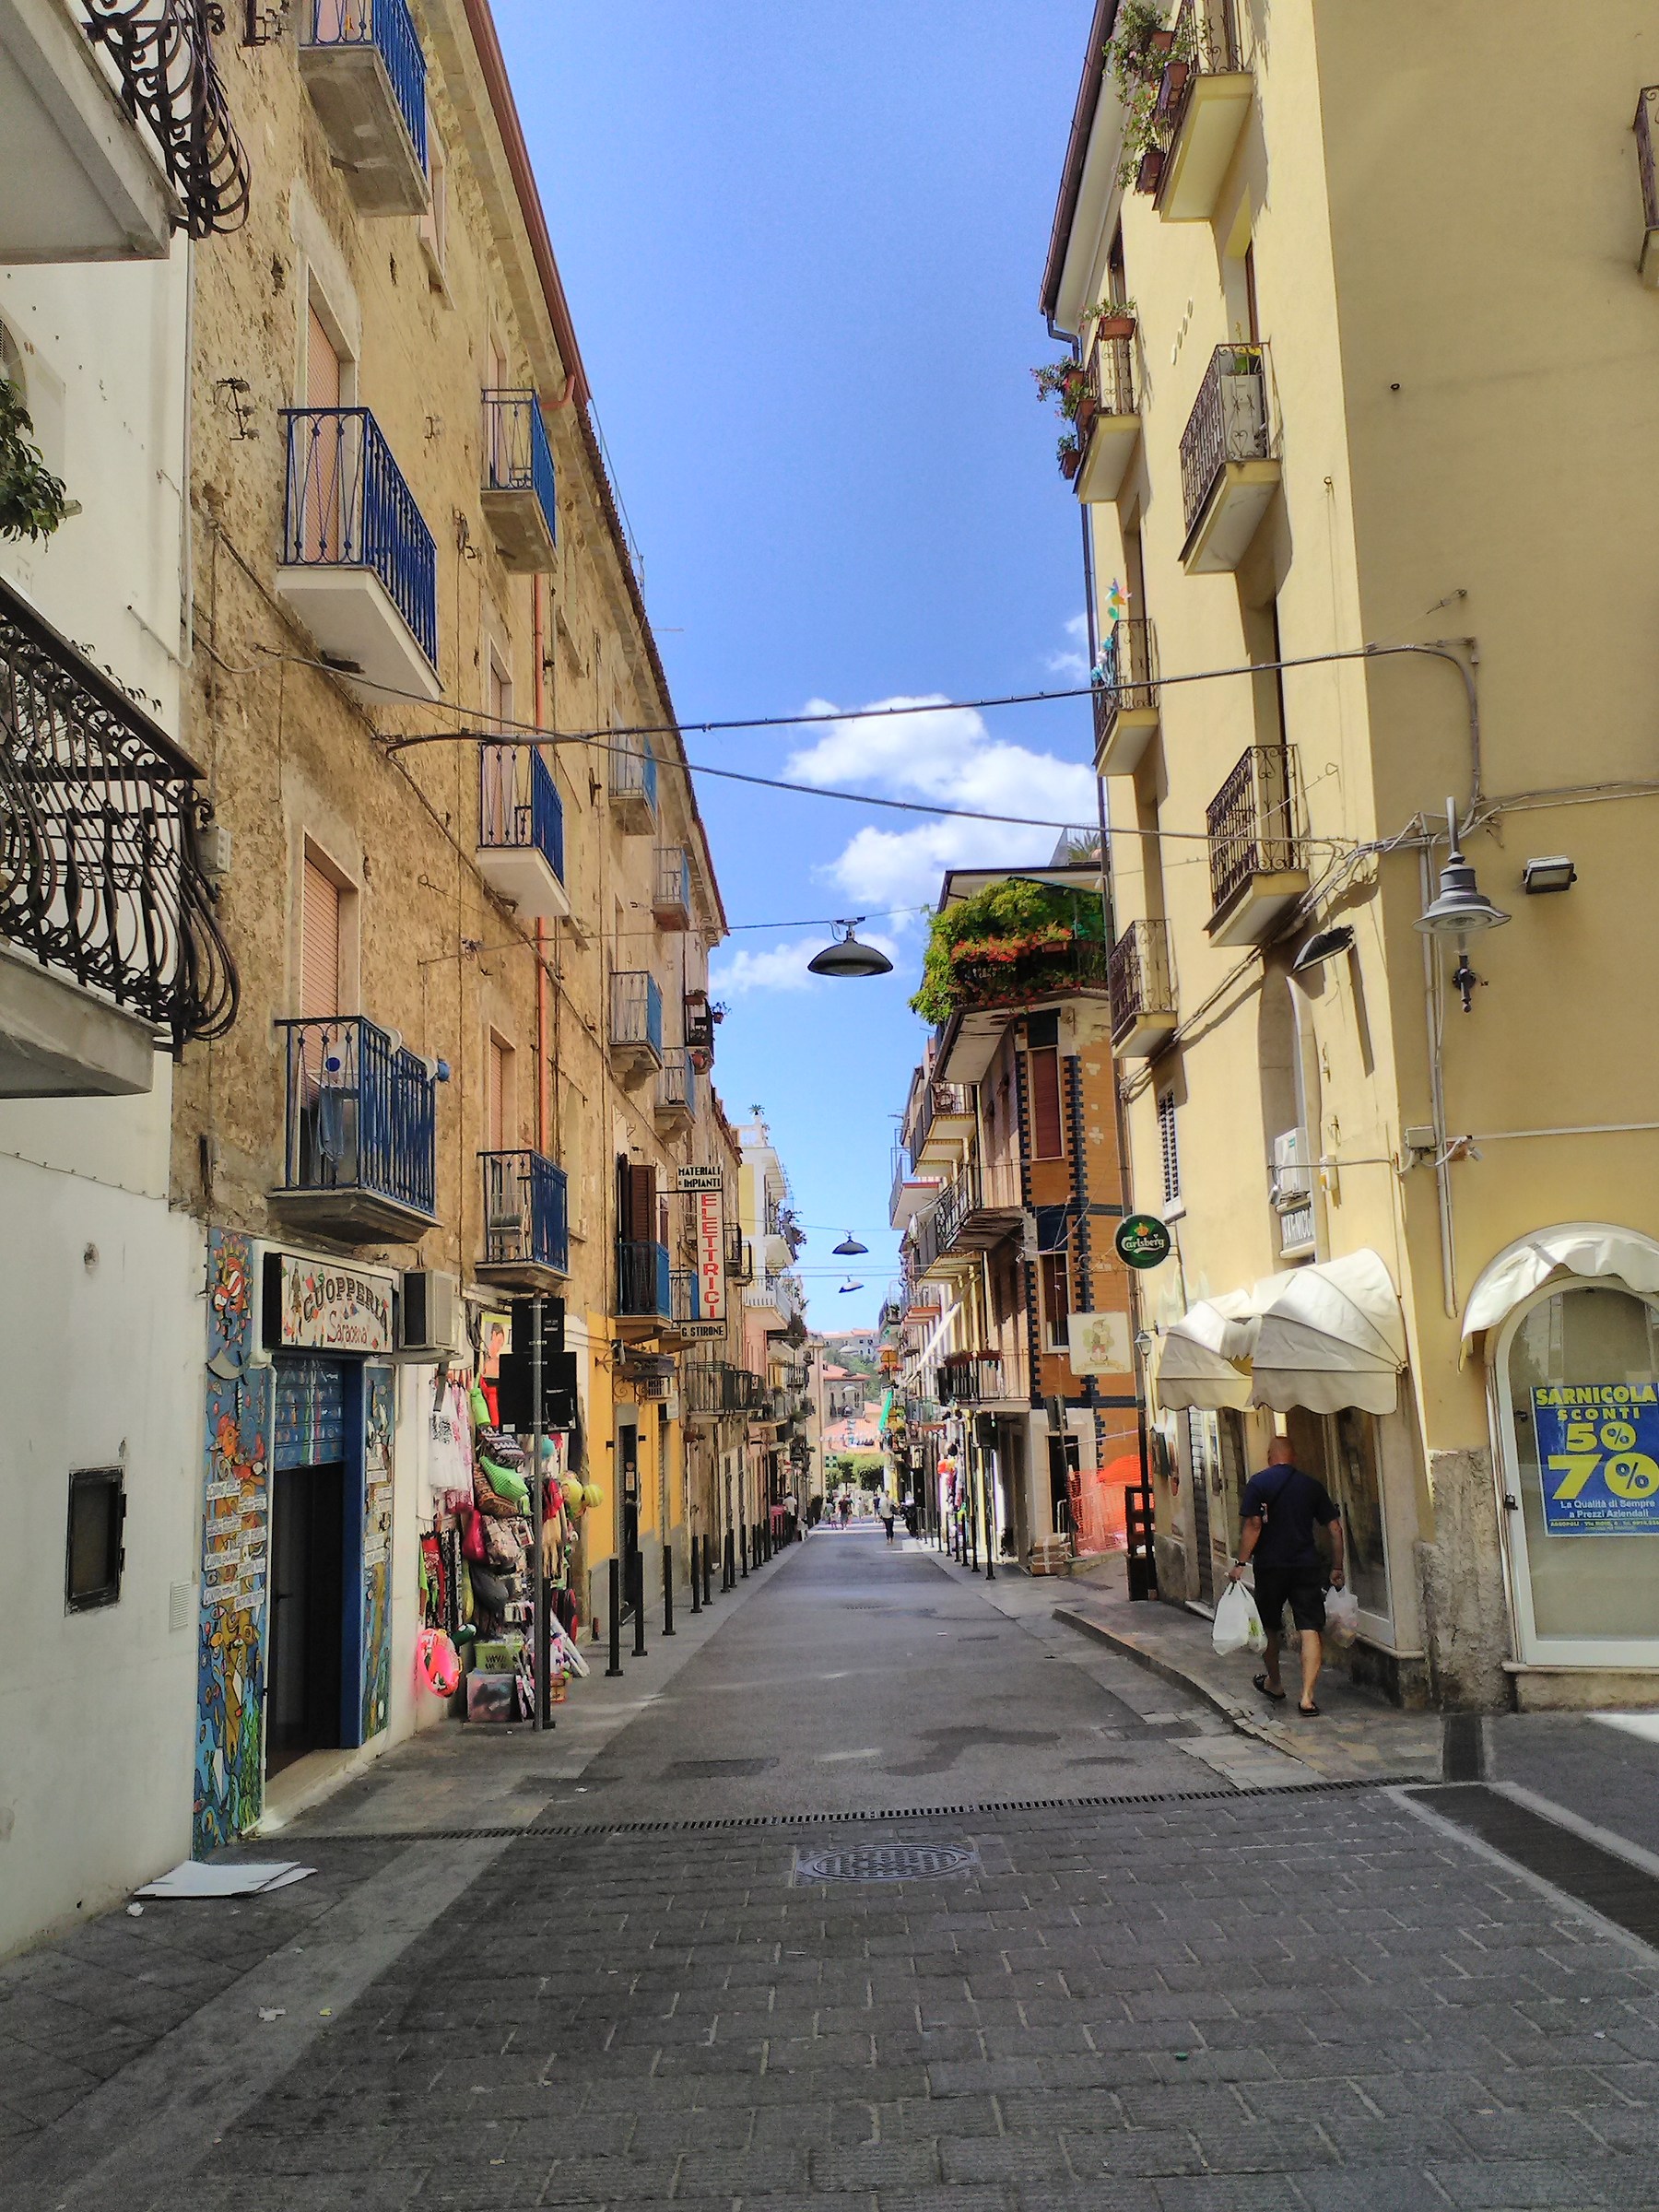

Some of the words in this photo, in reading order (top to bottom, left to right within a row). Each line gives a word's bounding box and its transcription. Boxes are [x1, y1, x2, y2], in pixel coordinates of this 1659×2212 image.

[678, 1166, 721, 1176] MATERIALI
[684, 1178, 720, 1188] IMPIANTI
[1121, 1235, 1165, 1252] Carlsberg
[700, 1194, 720, 1319] ELETTRICI
[304, 1277, 388, 1342] CUOPPERIA
[327, 1310, 368, 1344] Saracena
[682, 1326, 689, 1337] G.
[690, 1325, 724, 1337] STIRONE
[1535, 1385, 1657, 1406] SARNICOLA
[1557, 1406, 1641, 1421] SCONTI
[1560, 1500, 1572, 1509] La
[1574, 1500, 1606, 1509] Qualità
[1608, 1500, 1618, 1508] di
[1619, 1500, 1655, 1509] Sempre
[1577, 1510, 1605, 1518] Prezzi
[1606, 1509, 1649, 1518] Aziendali
